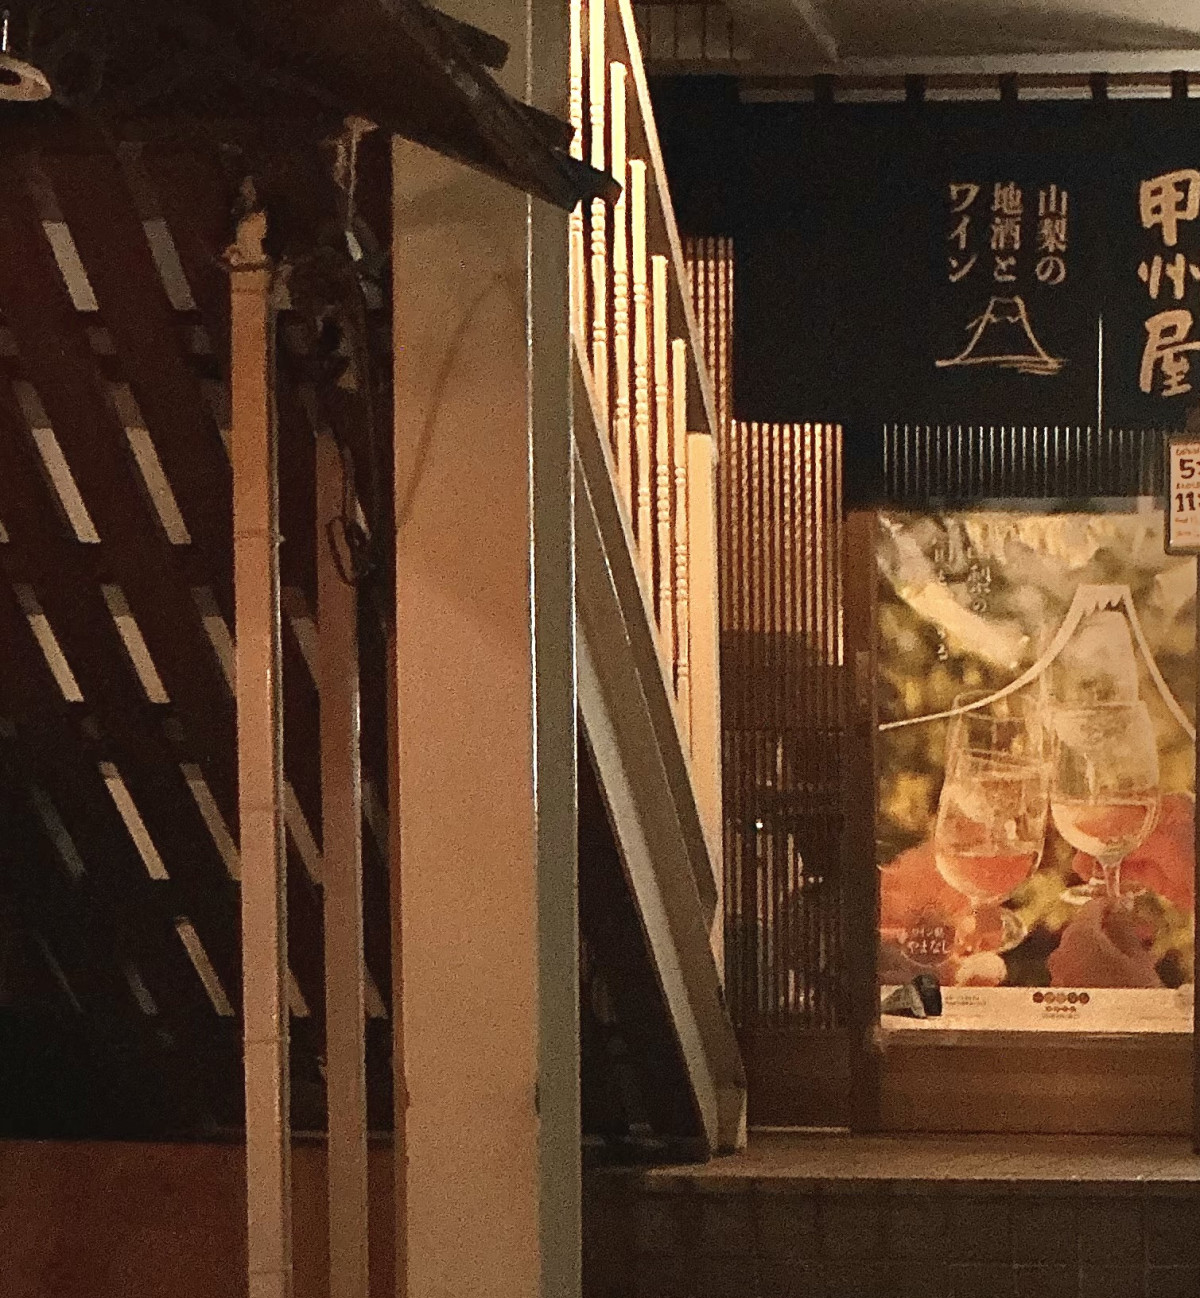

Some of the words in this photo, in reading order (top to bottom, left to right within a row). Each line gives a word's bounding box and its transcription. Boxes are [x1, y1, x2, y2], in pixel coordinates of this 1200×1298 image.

[949, 183, 981, 283] ワイン
[990, 181, 1023, 282] 地酒と
[1035, 184, 1069, 284] 山梨の
